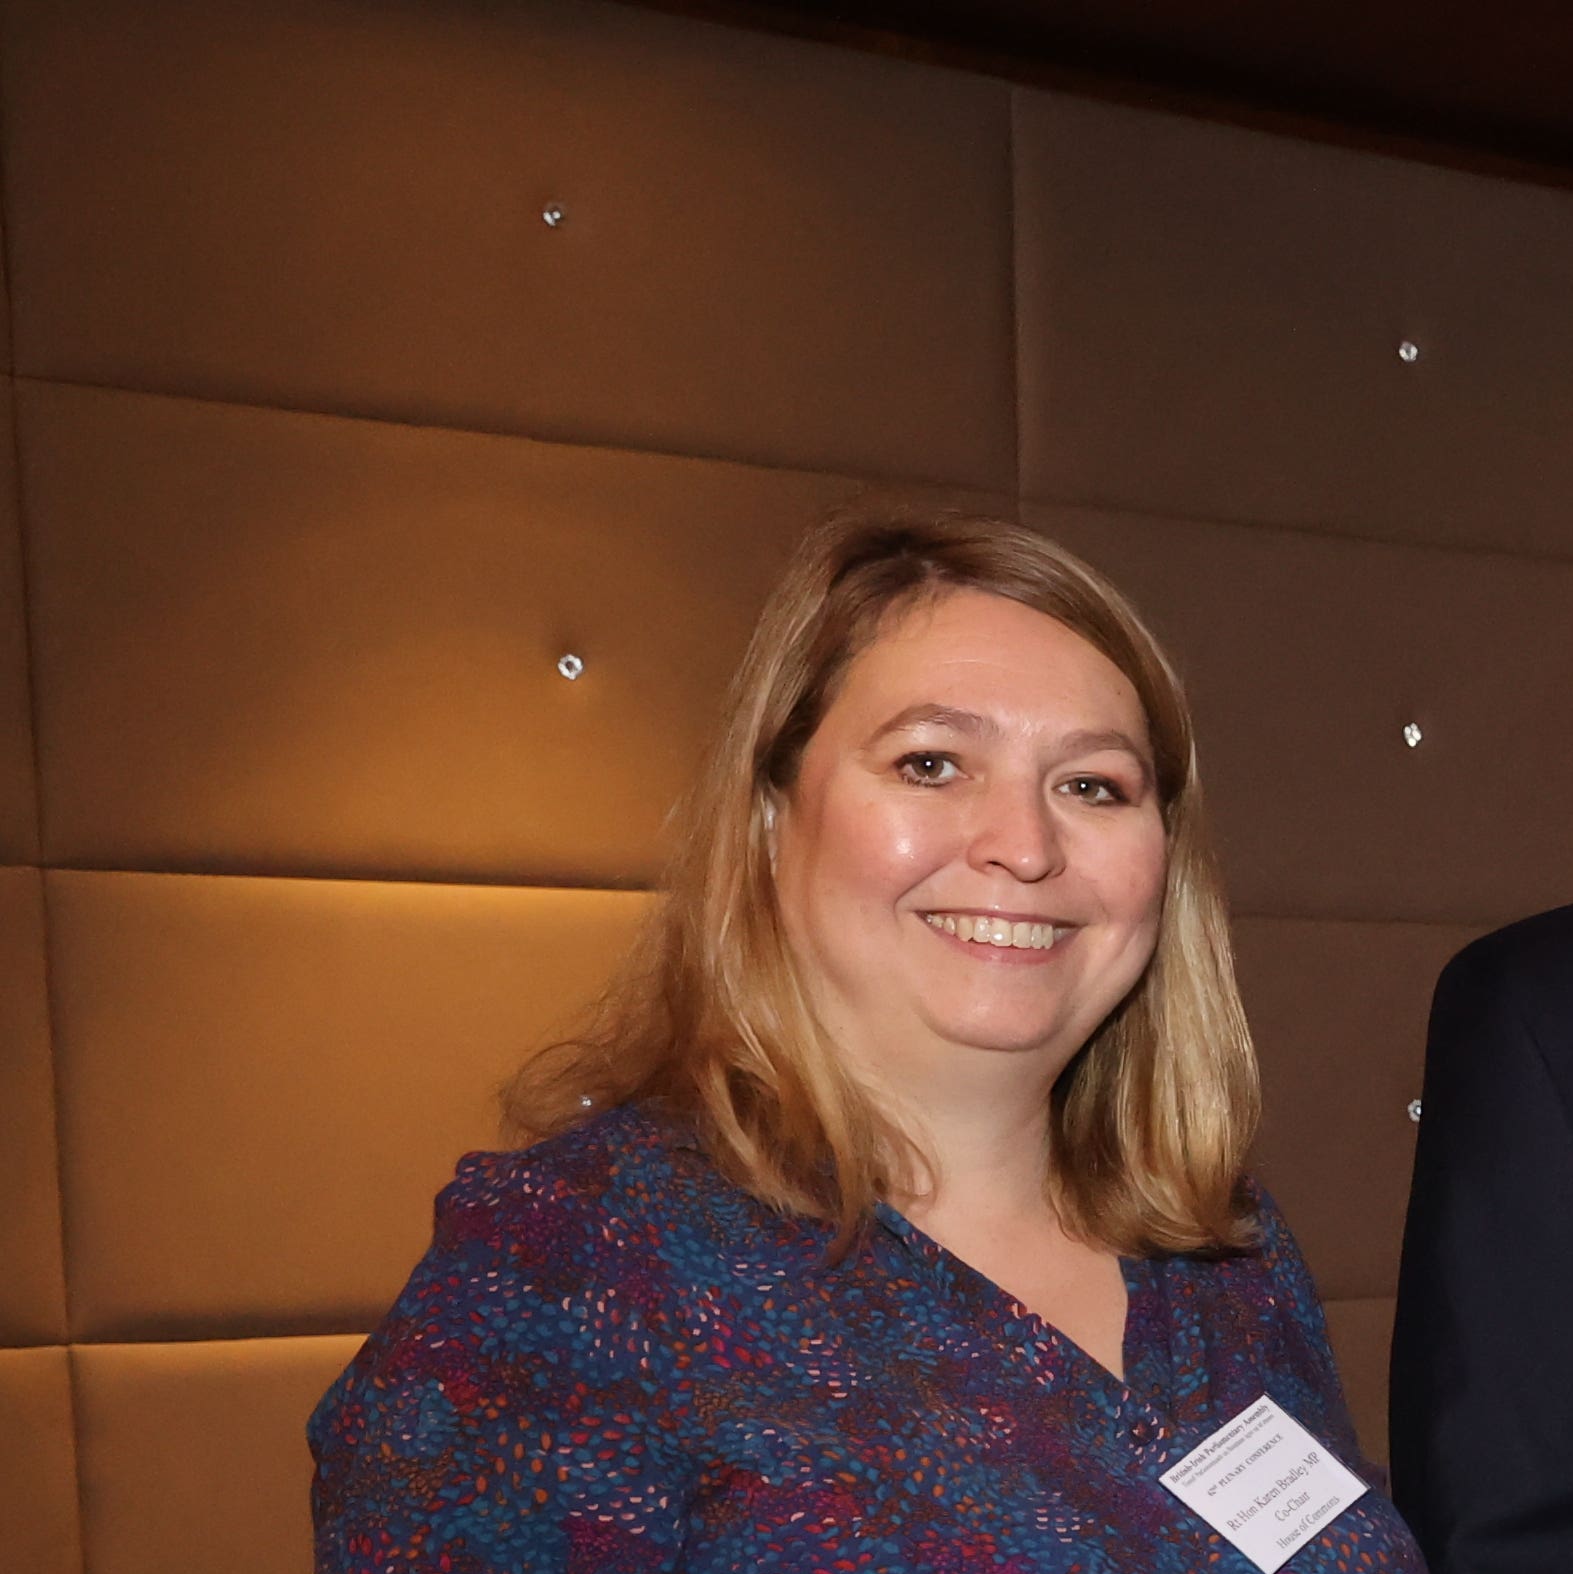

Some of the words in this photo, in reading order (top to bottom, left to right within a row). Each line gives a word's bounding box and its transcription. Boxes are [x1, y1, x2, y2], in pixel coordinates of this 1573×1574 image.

[1226, 1518, 1243, 1531] Rt
[1235, 1505, 1259, 1522] Hon
[1253, 1487, 1281, 1508] Karen
[1274, 1464, 1309, 1491] Bradley
[1302, 1451, 1320, 1468] MP
[1274, 1491, 1311, 1522] Co-Chair
[1275, 1528, 1302, 1549] House
[1298, 1518, 1309, 1532] of
[1304, 1495, 1340, 1525] Commons
